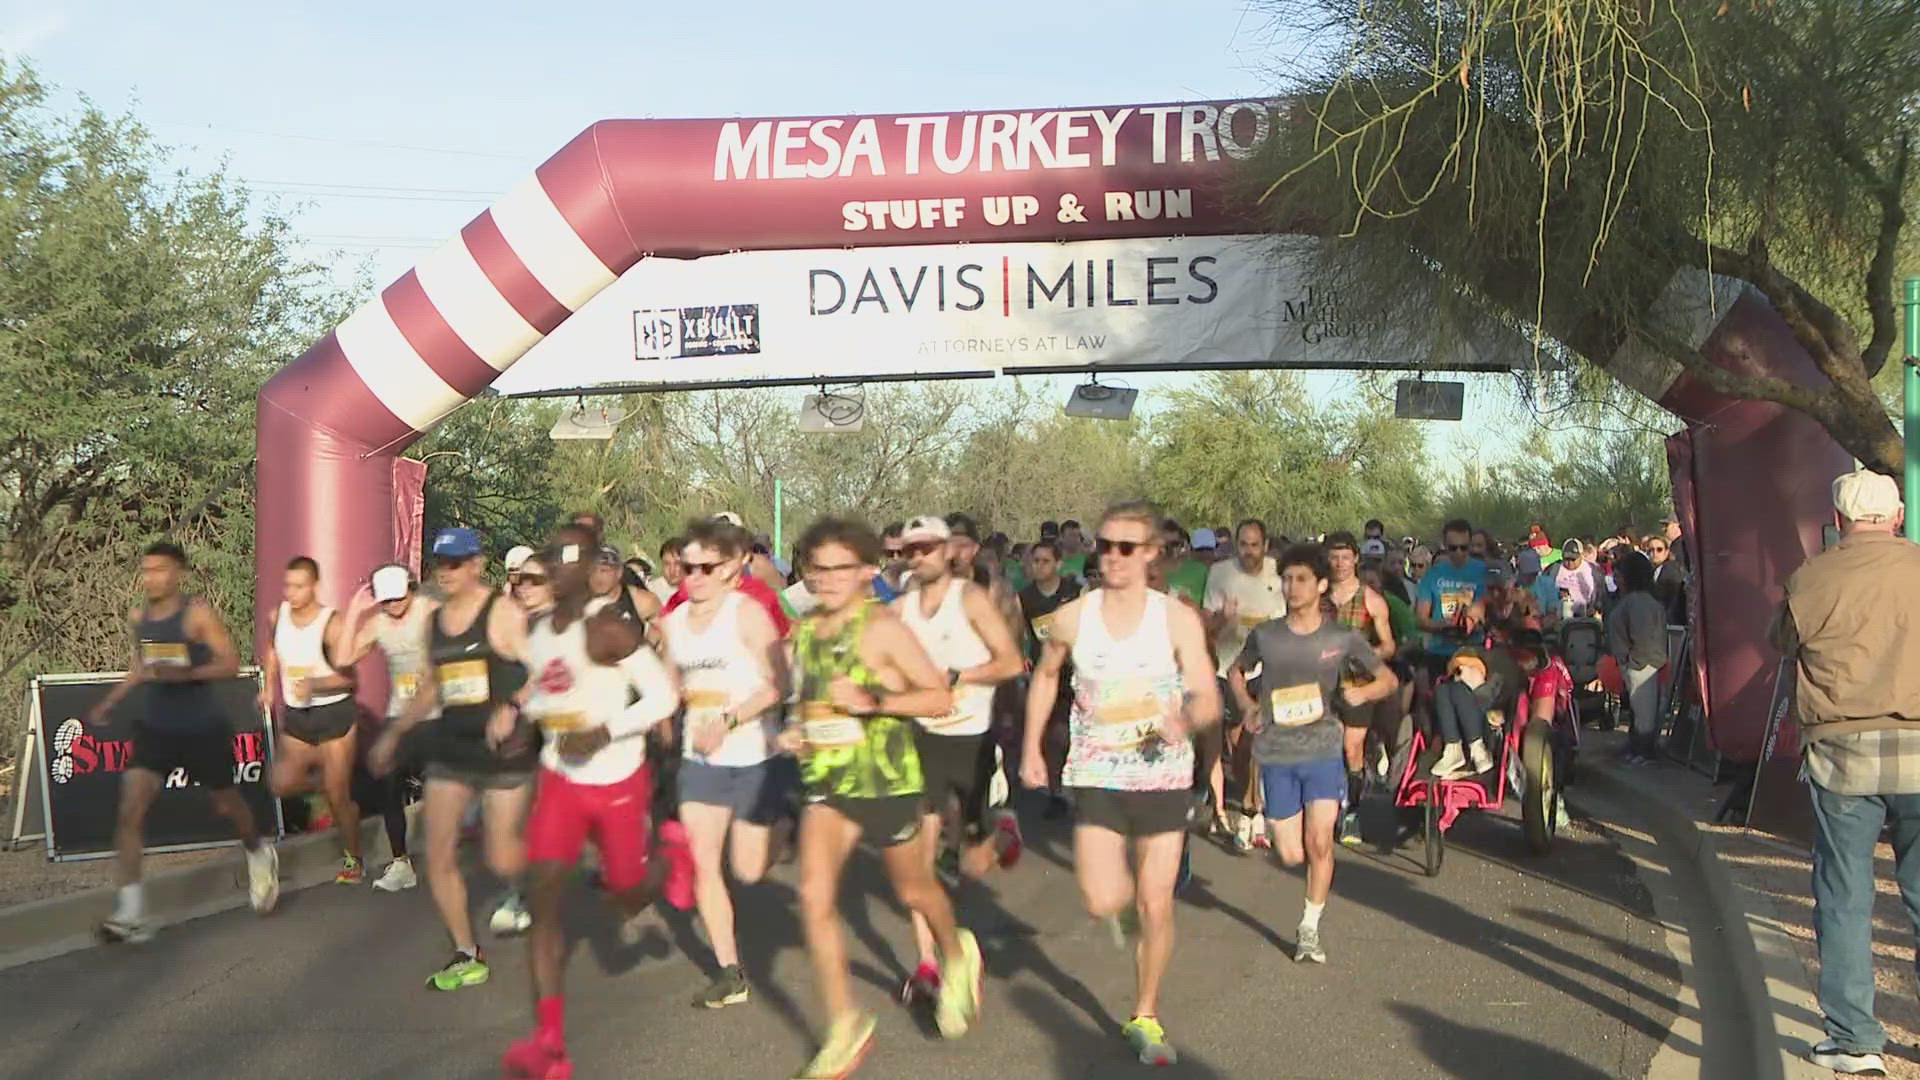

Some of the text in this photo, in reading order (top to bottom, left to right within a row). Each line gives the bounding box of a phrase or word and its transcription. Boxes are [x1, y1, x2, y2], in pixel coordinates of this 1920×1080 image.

[713, 119, 886, 181] MESA
[895, 107, 1135, 177] TURKEY
[841, 189, 1193, 231] STUFF UP & RUN
[809, 256, 1218, 316] DAVIS MILES
[1035, 336, 1056, 351] AT
[1065, 335, 1106, 351] LAW
